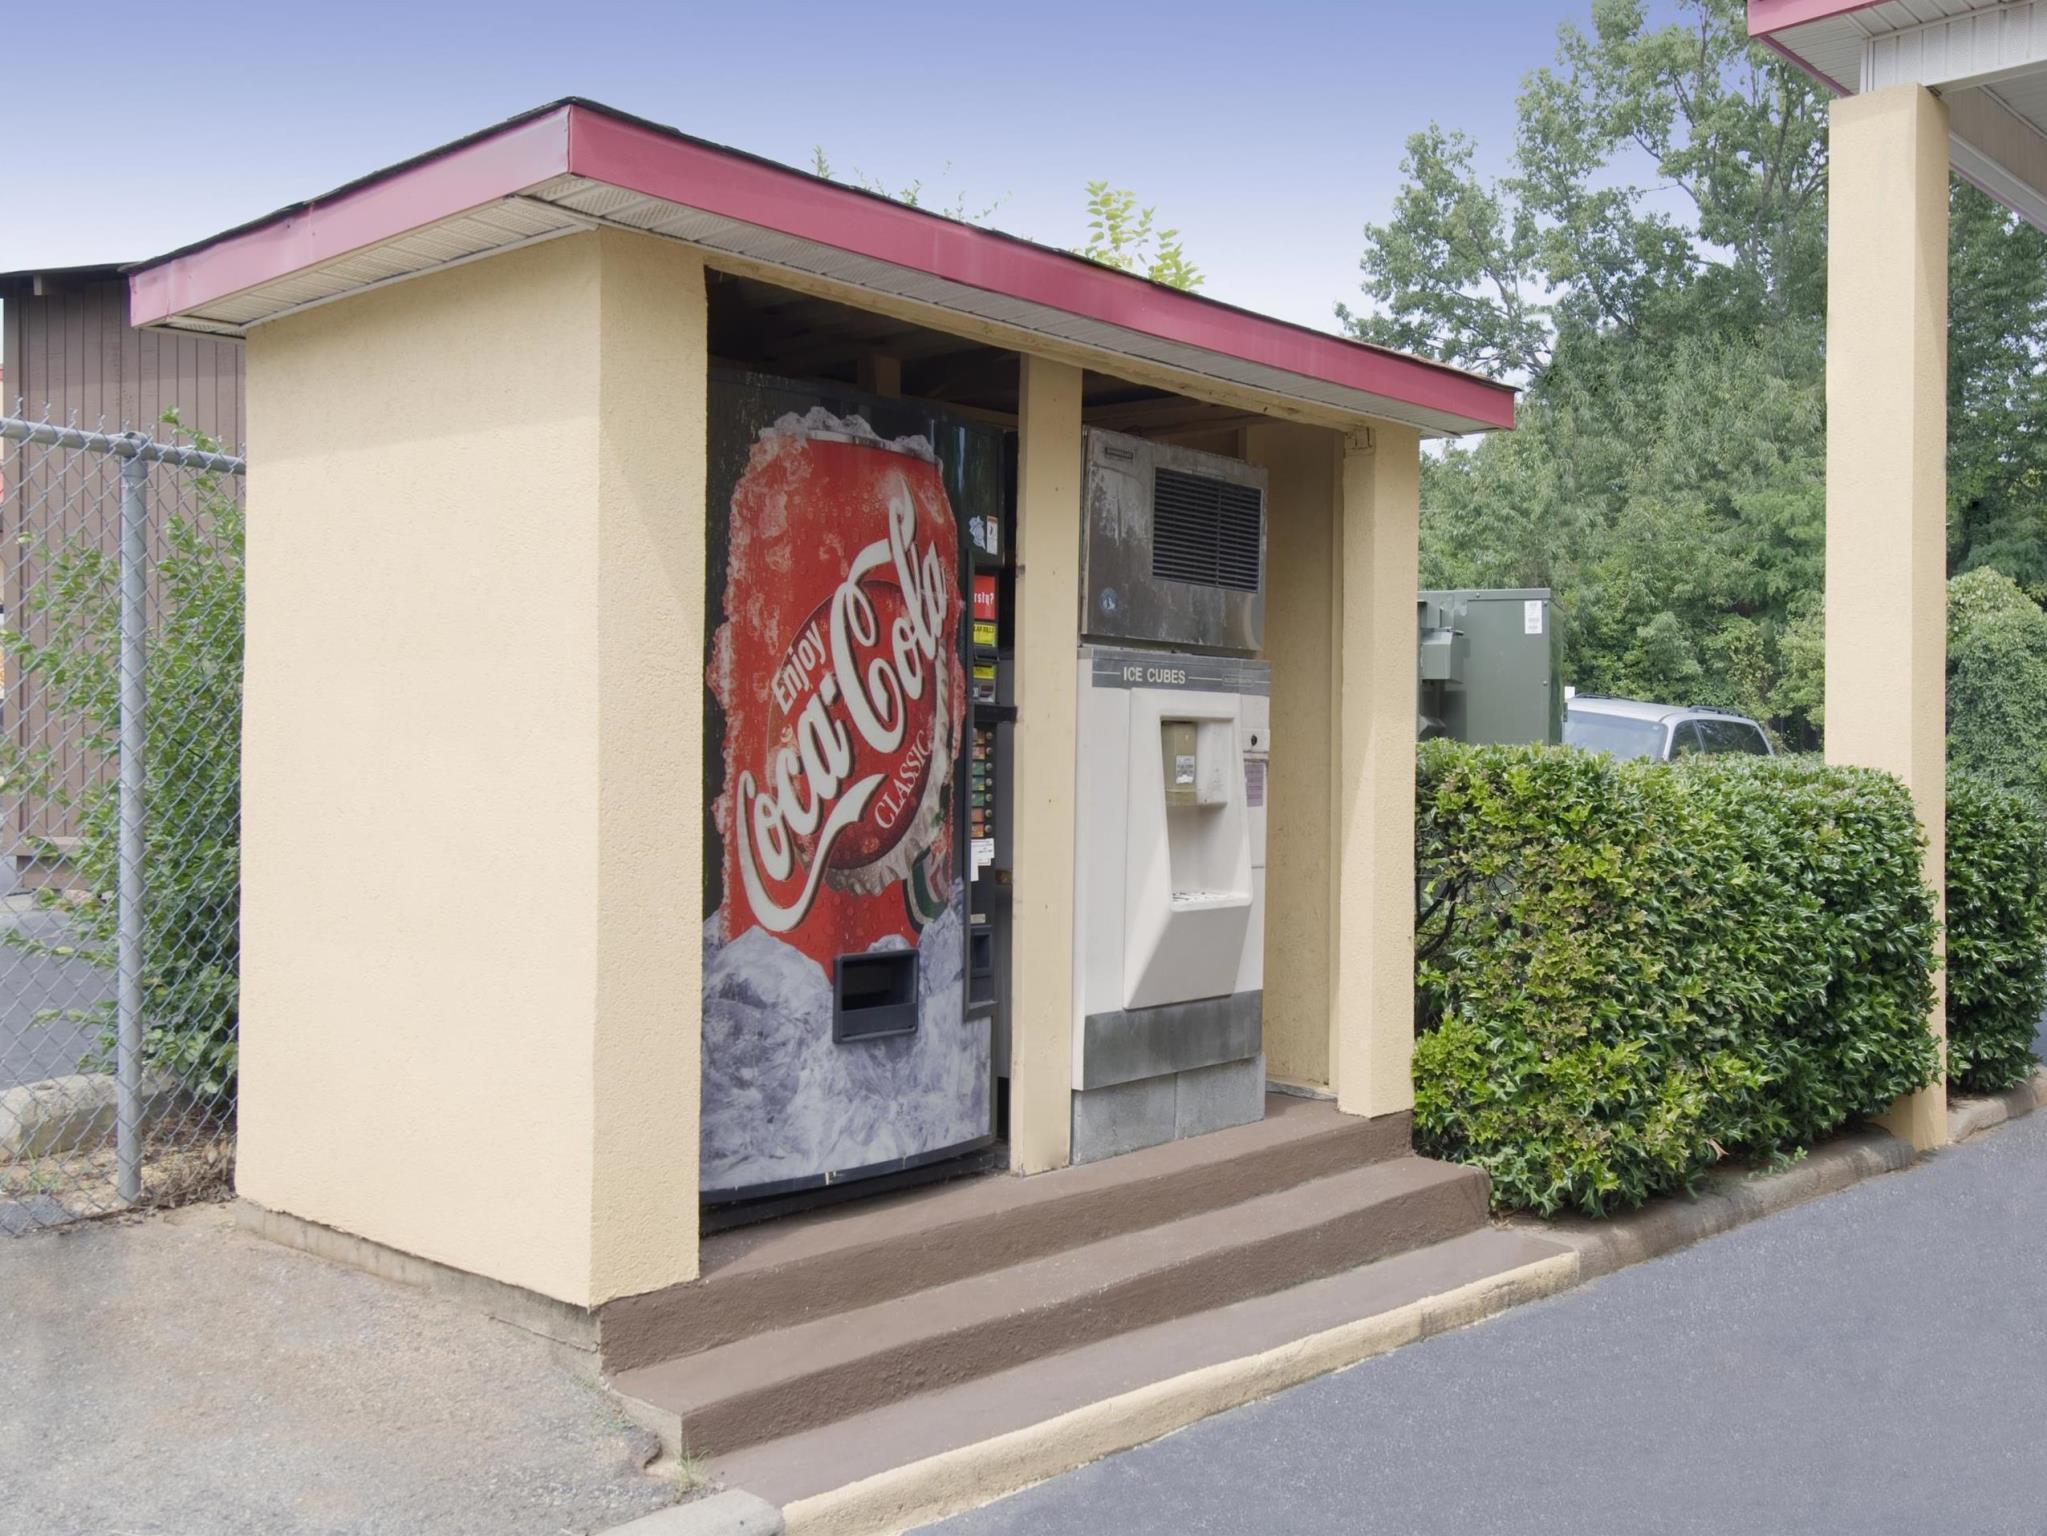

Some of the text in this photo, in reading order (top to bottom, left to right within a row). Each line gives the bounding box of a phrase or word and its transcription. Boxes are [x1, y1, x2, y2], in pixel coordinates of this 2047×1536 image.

[735, 472, 948, 932] Coca-Cola
[771, 620, 827, 716] Enjoy
[1123, 666, 1186, 684] ICE CUBES
[874, 730, 933, 830] CLASSIC
